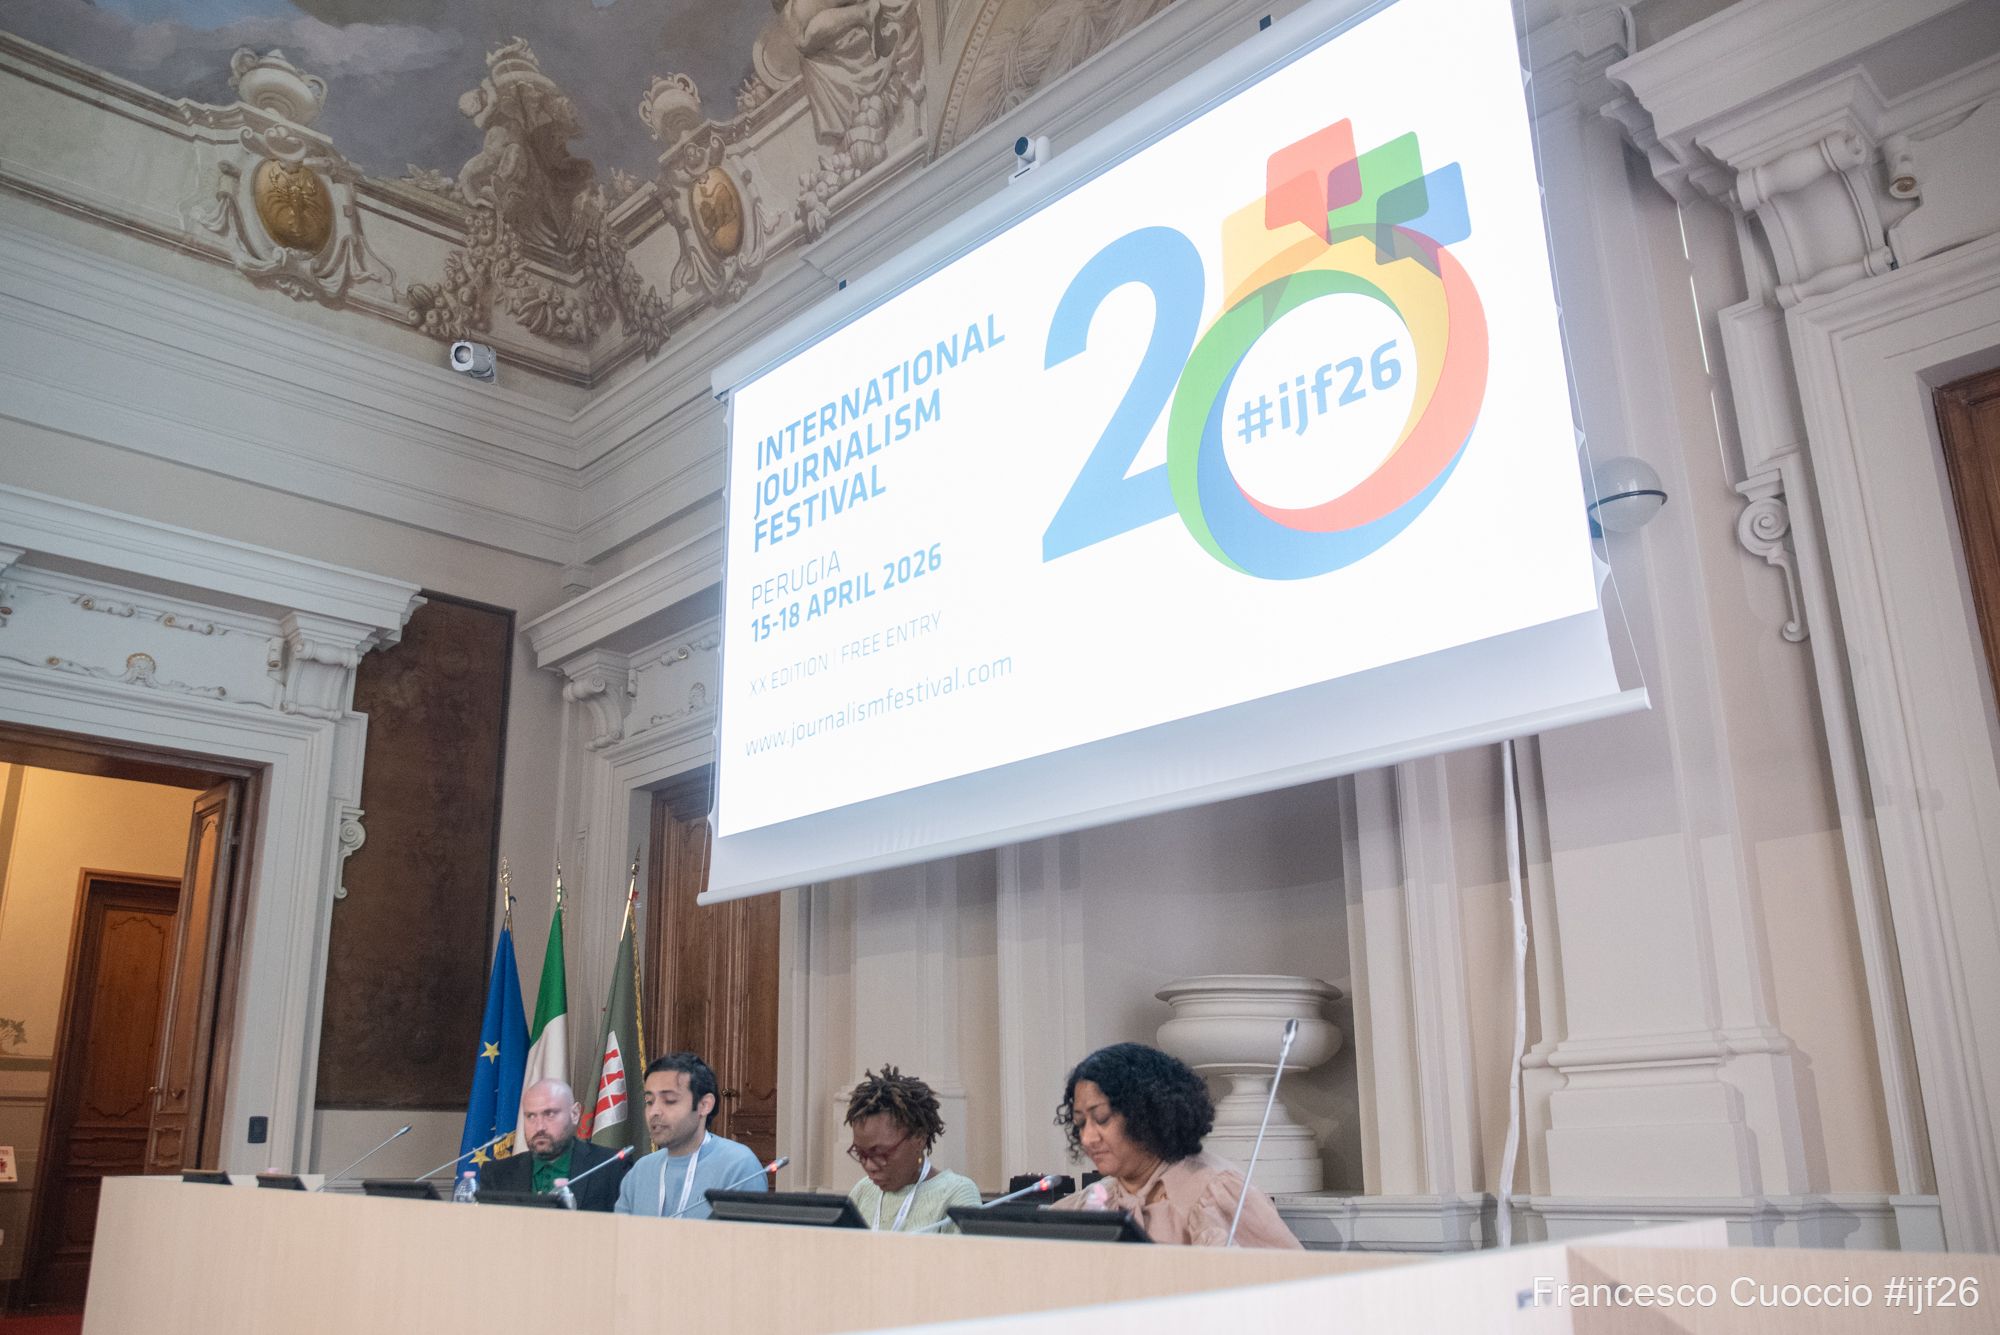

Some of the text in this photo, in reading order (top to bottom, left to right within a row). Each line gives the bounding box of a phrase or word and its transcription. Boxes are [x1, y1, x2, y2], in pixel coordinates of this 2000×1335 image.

[757, 313, 1006, 471] INTERNATIONAL
[1237, 339, 1402, 445] #ijf26
[754, 389, 941, 520] JOURNALISM
[754, 465, 886, 552] FESTIVAL
[751, 550, 841, 609] PERUGIA
[751, 542, 942, 642] 15-18 APRIL 2026
[749, 610, 943, 697] XX EDITION FREE ENTRY
[746, 655, 1012, 757] www.journalismfestival.com
